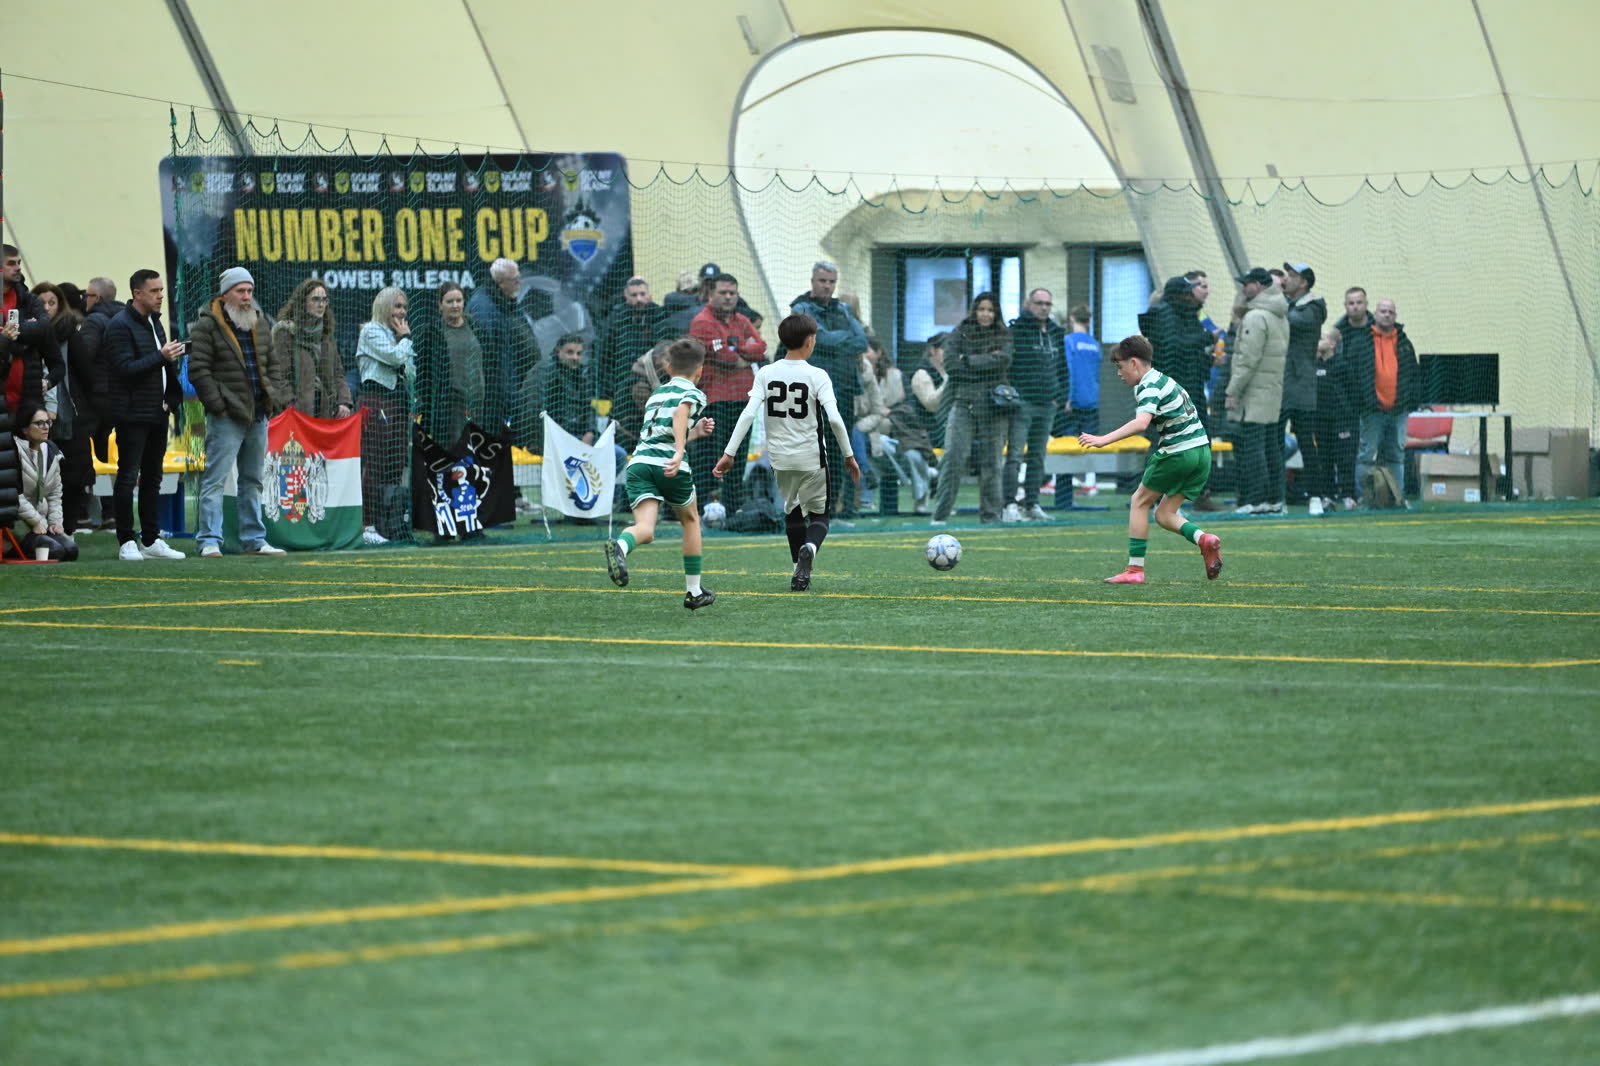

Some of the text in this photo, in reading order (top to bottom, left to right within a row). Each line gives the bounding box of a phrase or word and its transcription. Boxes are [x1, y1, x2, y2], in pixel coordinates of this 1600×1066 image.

[234, 207, 549, 262] NUMBER ONE CUP
[391, 269, 476, 289] SILESIA
[767, 381, 808, 419] 23
